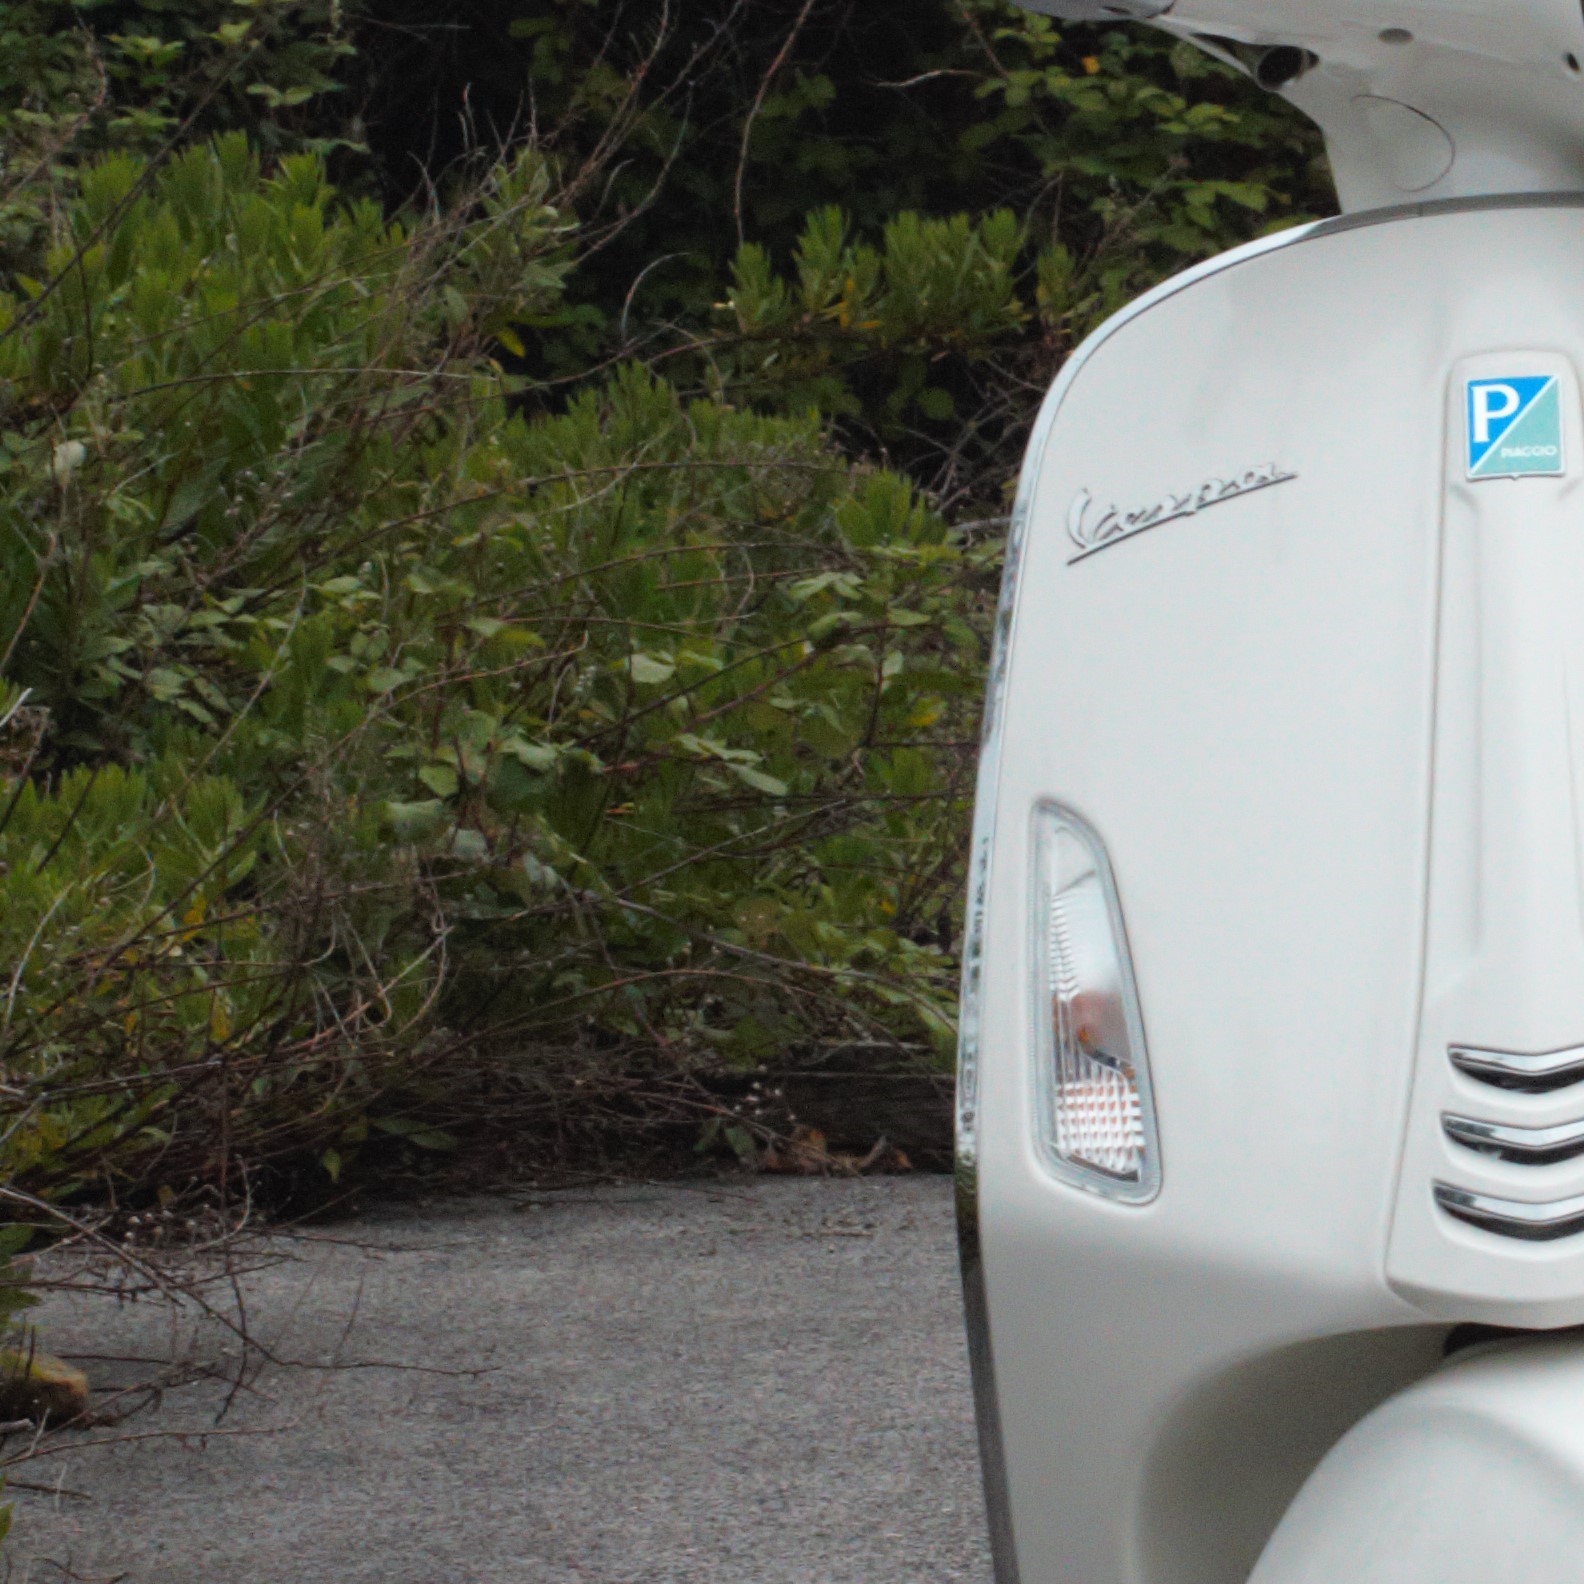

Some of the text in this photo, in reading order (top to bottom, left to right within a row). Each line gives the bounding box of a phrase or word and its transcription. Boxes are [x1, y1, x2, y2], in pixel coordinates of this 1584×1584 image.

[1471, 383, 1520, 443] P
[1501, 445, 1557, 458] PIAGGIO
[1066, 462, 1297, 566] Vespa
